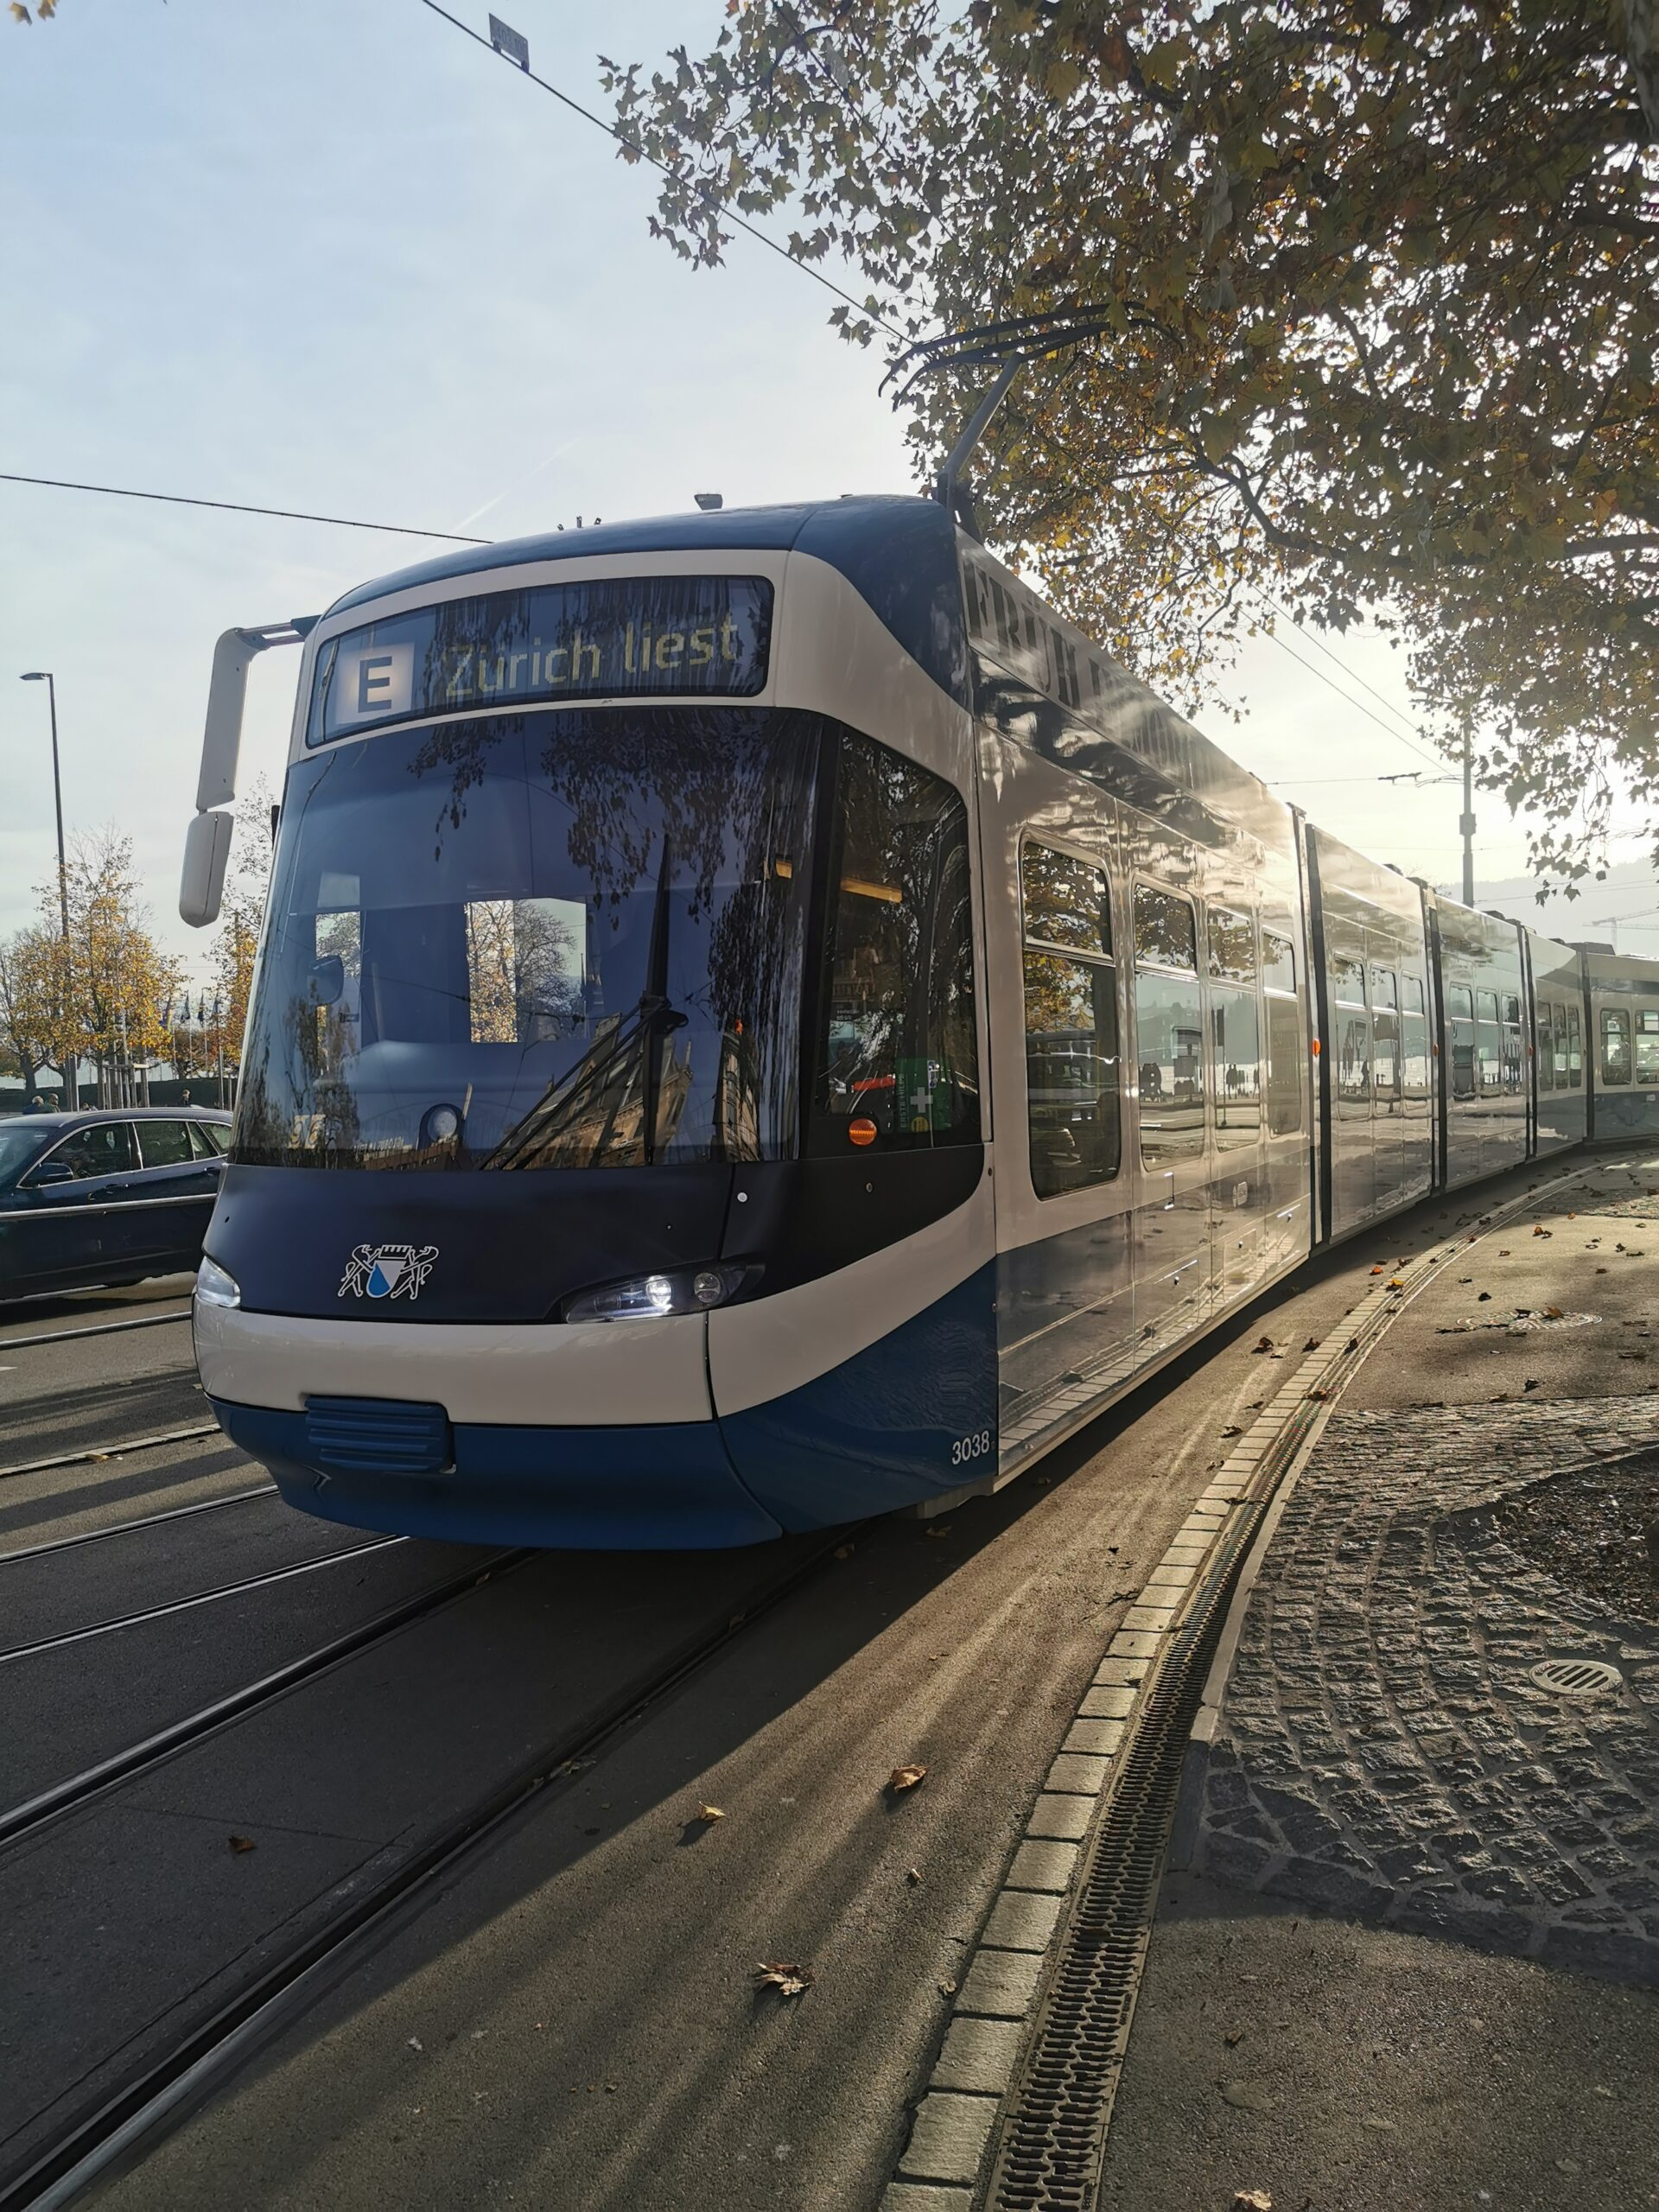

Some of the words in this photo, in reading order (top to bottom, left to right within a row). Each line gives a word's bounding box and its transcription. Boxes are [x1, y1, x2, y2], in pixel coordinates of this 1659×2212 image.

[446, 632, 600, 696] Zürich
[626, 613, 738, 674] liest
[358, 656, 393, 713] E
[951, 1430, 990, 1465] 3038
